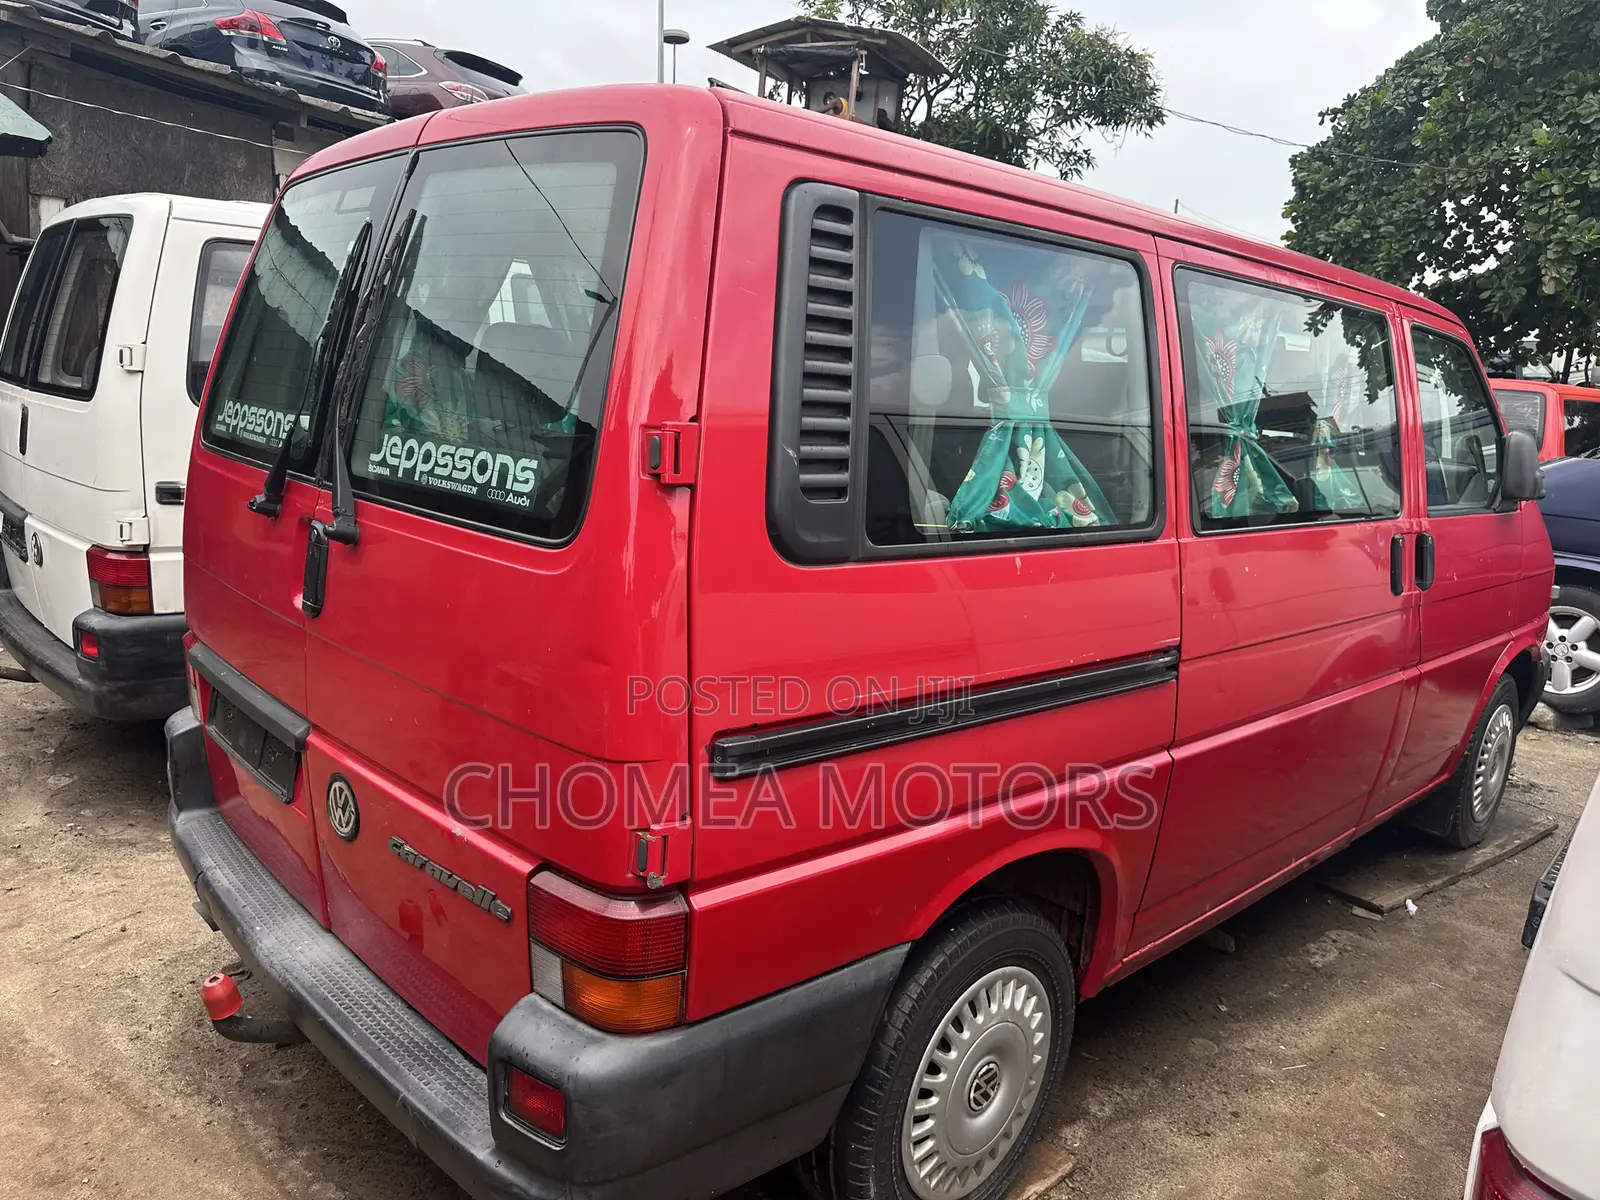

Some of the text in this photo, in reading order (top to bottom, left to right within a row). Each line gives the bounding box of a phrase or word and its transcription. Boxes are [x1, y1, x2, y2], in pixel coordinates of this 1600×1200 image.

[367, 464, 390, 477] SCANIA
[428, 476, 478, 496] VOLKSWAGEN
[505, 492, 530, 507] Audi
[388, 835, 513, 923] Caravelle
